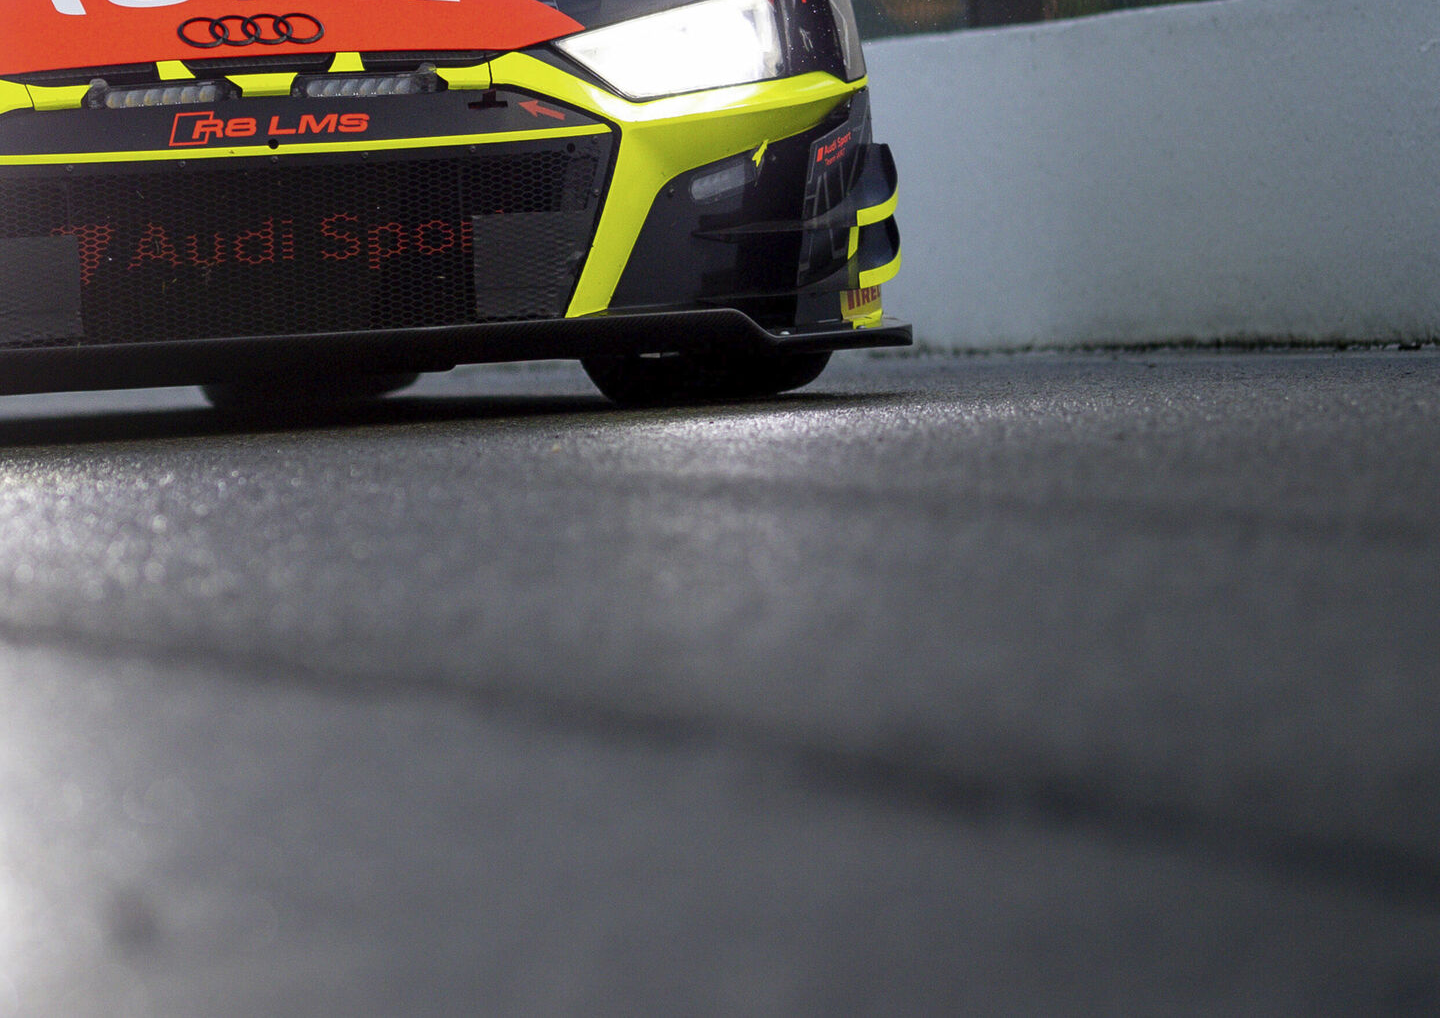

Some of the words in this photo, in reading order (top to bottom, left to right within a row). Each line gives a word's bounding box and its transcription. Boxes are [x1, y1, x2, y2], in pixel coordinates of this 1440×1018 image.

[268, 112, 370, 136] LMS
[126, 216, 296, 270] Audi
[320, 212, 475, 269] Spo
